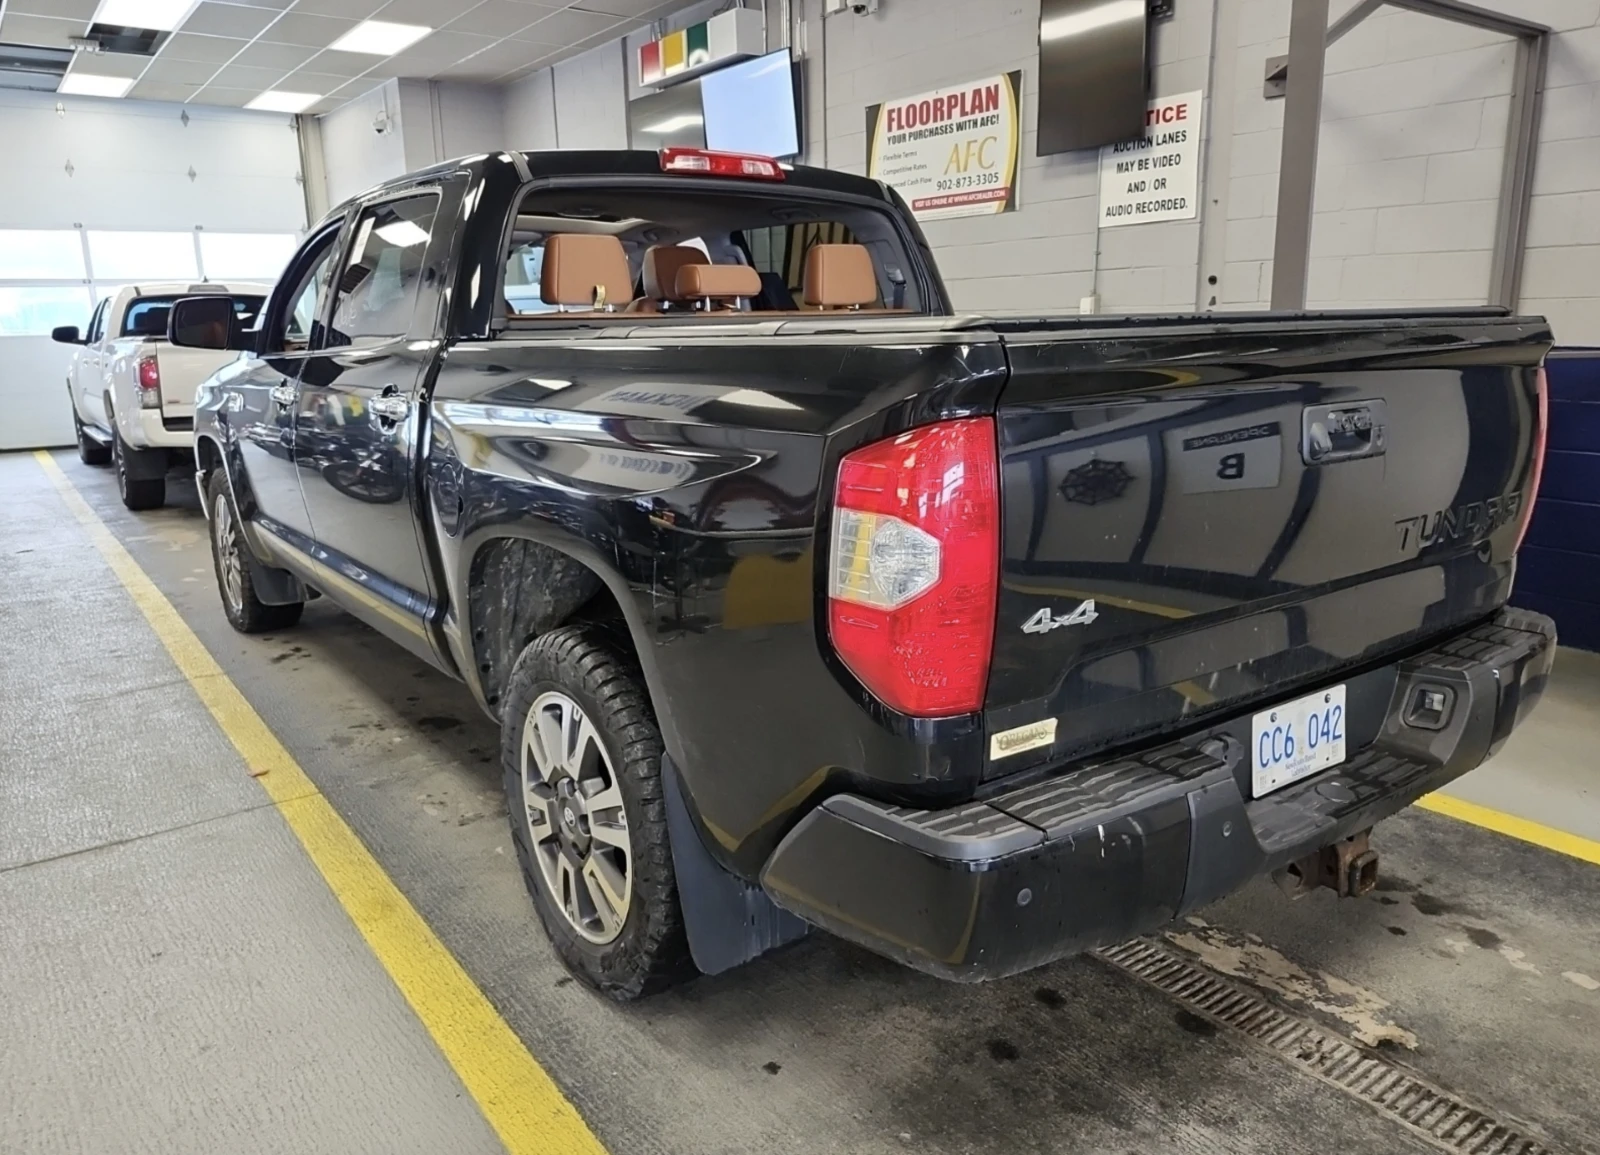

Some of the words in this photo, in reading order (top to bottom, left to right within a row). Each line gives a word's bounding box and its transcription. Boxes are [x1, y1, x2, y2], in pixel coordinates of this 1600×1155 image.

[887, 84, 999, 133] FLOORPLAN
[1145, 103, 1188, 127] TICE
[887, 132, 906, 146] YOUR
[908, 123, 954, 142] PURCHASES
[955, 119, 978, 132] WITH
[980, 114, 999, 128] AFC!
[1113, 136, 1153, 154] AUCTION
[1156, 130, 1187, 146] LANES
[902, 151, 917, 159] Terms
[943, 136, 997, 175] AFC
[1116, 160, 1136, 174] MAY
[1137, 158, 1150, 171] BE
[1152, 153, 1181, 169] VIDEO
[883, 165, 912, 176] Competitive
[913, 163, 928, 171] Rates
[907, 178, 919, 186] Cash
[919, 176, 932, 184] Flow
[936, 172, 999, 191] 902-873-3305
[1127, 180, 1146, 194] AND
[1153, 177, 1167, 191] OR
[947, 197, 954, 205] AT
[1105, 203, 1133, 218] AUDIO
[1135, 197, 1188, 214] RECORDED.
[1395, 491, 1522, 552] TUNDRA
[1020, 598, 1099, 634] 4x4
[1260, 722, 1295, 768] CC6
[1308, 704, 1342, 749] 042
